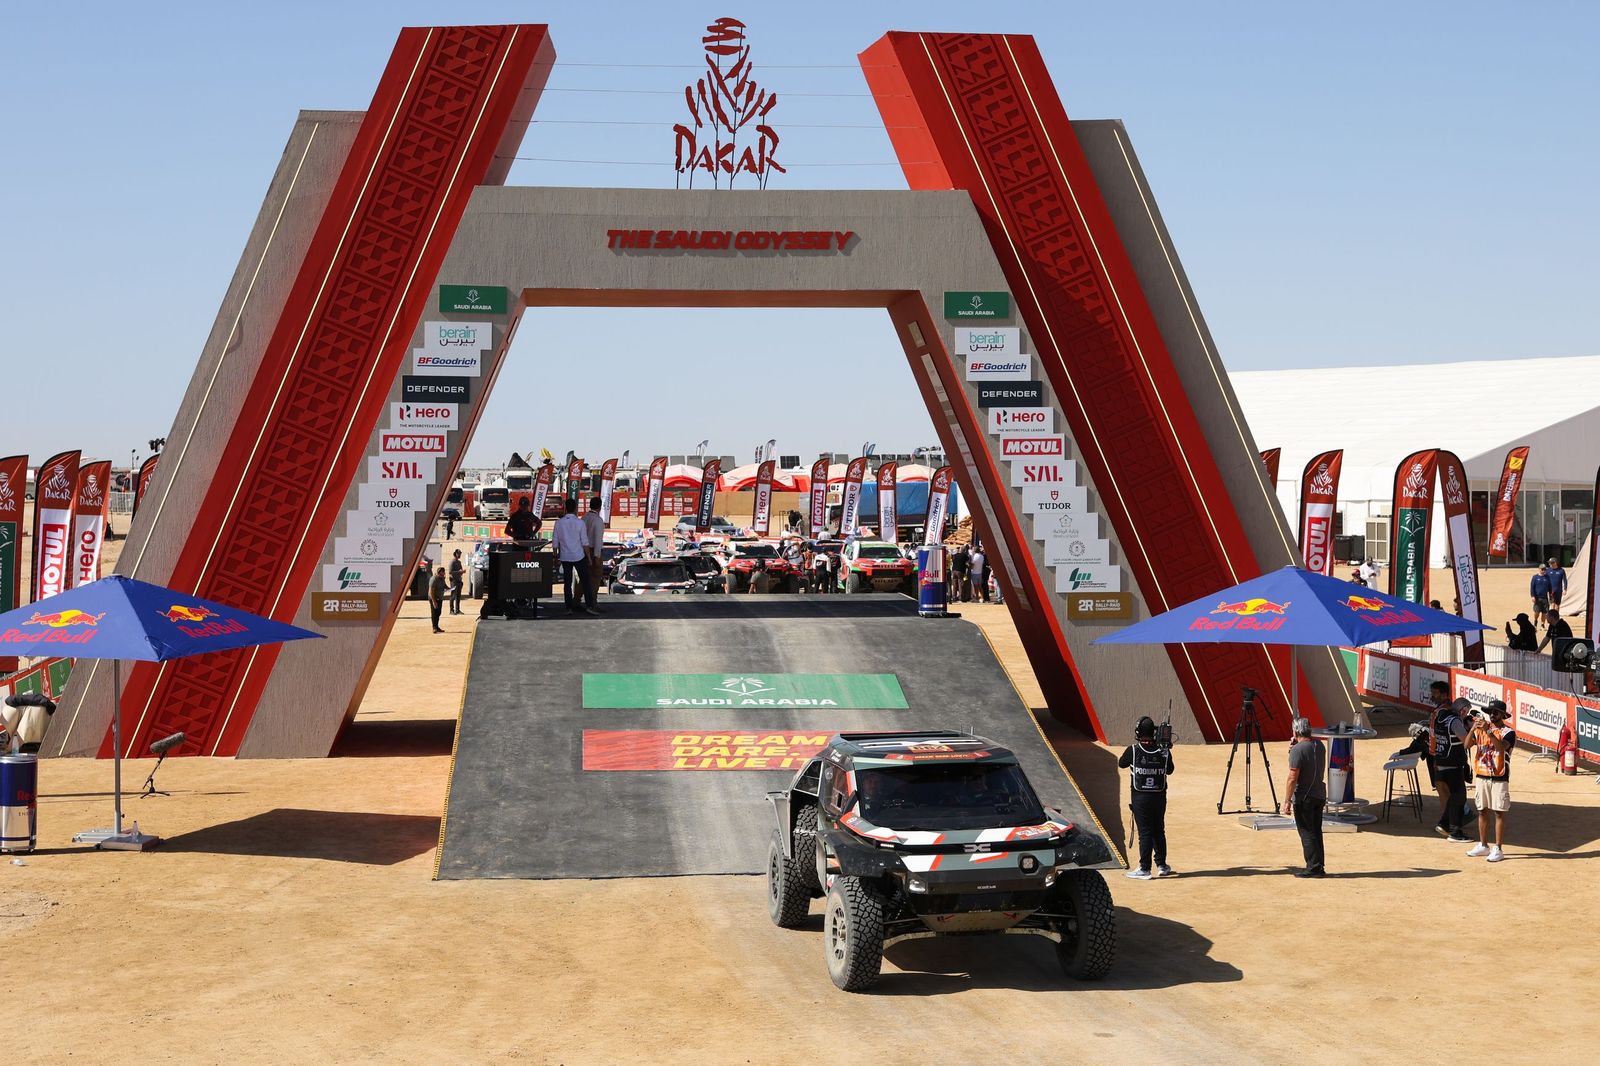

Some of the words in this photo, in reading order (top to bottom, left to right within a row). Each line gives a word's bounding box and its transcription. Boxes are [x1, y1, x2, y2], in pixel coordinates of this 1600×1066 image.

[673, 124, 786, 174] DAKAR
[607, 230, 655, 249] THE
[655, 230, 732, 250] SAUDI
[735, 231, 854, 250] ODYSSEY
[440, 326, 477, 339] berain
[970, 331, 1005, 344] berain
[418, 357, 477, 366] BFGoodrich
[970, 363, 1027, 371] BFGoodrich
[407, 385, 465, 393] DEFENDER
[982, 390, 1037, 398] DEFENDER
[416, 407, 450, 418] Hero
[1012, 412, 1045, 422] Hero
[386, 437, 442, 449] MOTUL
[1005, 440, 1060, 453] MOTUL
[45, 487, 71, 500] DAKAR
[1310, 484, 1334, 496] DAKAR
[1403, 486, 1428, 499] DAKAR
[80, 497, 104, 508] DAKAR
[702, 484, 712, 525] DEFENDER
[814, 491, 823, 524] MOTUL
[846, 493, 855, 523] TUDOR
[1038, 502, 1071, 510] TUDOR
[1309, 520, 1327, 571] OTUL
[80, 530, 96, 582] Hero
[1406, 541, 1416, 580] ARABIA
[43, 528, 64, 600] MOTUL
[1458, 554, 1471, 607] berain
[323, 600, 339, 612] 2R
[1079, 600, 1093, 611] 2R
[1188, 616, 1239, 631] Red
[1235, 616, 1288, 631] Bull
[0, 629, 50, 643] Red
[45, 629, 97, 643] Bull
[656, 698, 732, 706] SAUDI
[740, 698, 838, 706] ARABIA
[1520, 702, 1562, 726] BFGoodrich
[670, 735, 828, 746] DREAM
[671, 746, 801, 757] DARE.
[673, 758, 770, 768] LIVE
[1136, 767, 1157, 775] PODIUM
